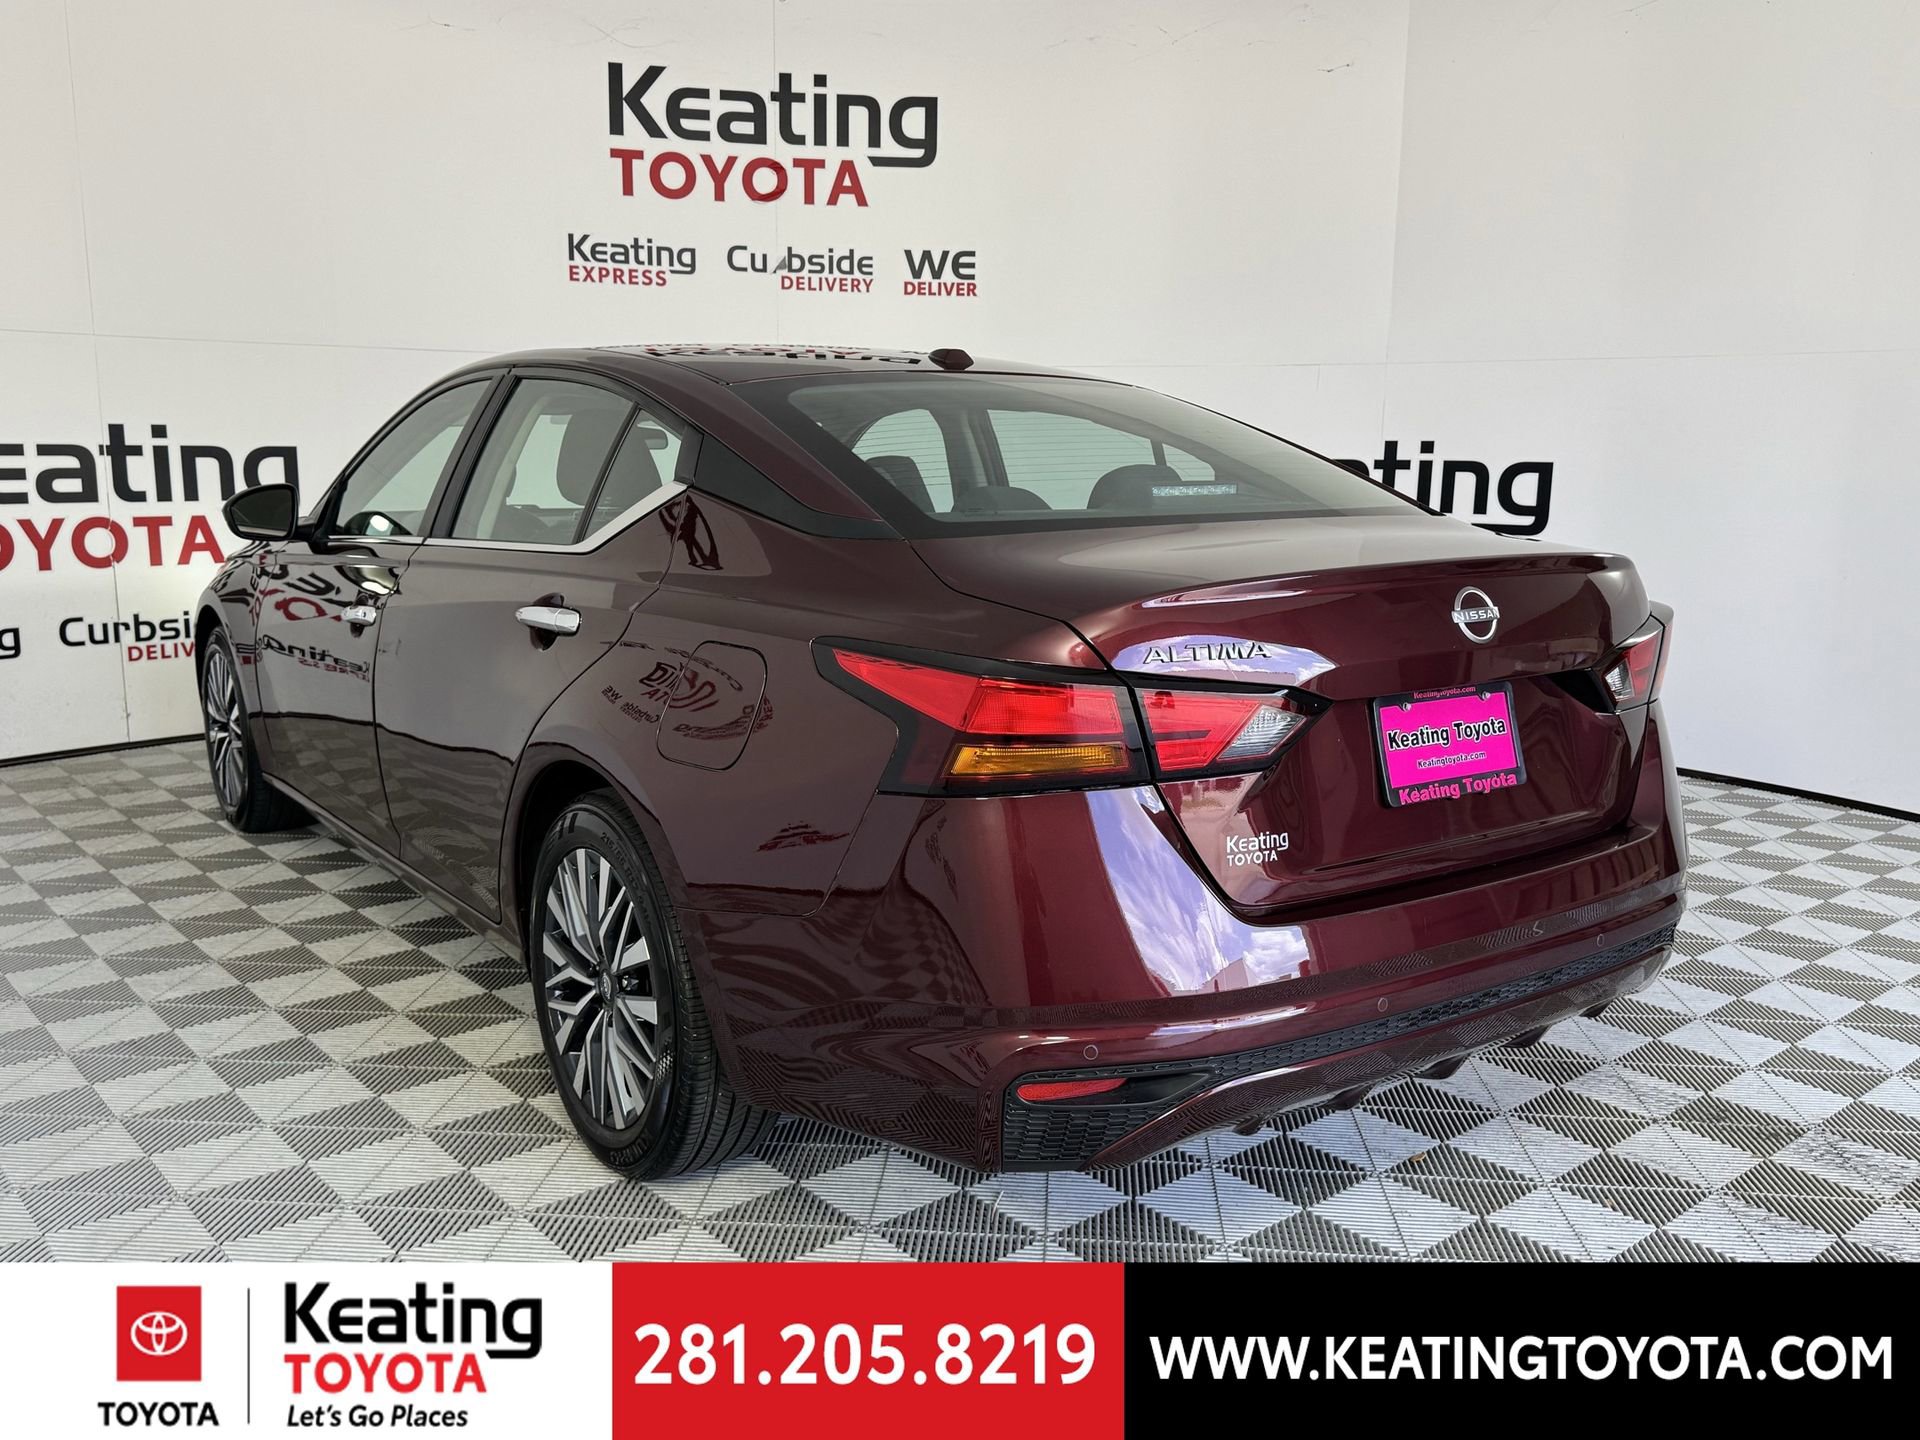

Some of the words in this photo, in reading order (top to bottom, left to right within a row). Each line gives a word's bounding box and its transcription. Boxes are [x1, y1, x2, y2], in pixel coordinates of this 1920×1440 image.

[608, 62, 938, 168] Keating
[609, 148, 869, 207] TOYOTA
[568, 233, 696, 275] Keating
[727, 245, 873, 276] Cubside
[904, 250, 976, 280] WE
[569, 265, 667, 286] EXPRESS
[781, 275, 873, 293] DELIVERY
[904, 281, 977, 297] DELIVER
[1454, 608, 1500, 622] NISSAN
[1144, 642, 1272, 664] ALTIMA
[1387, 724, 1450, 750] Keating
[1453, 717, 1507, 742] Toyota
[1399, 780, 1460, 805] Keating
[1463, 772, 1517, 794] Toyota
[1226, 831, 1289, 853] Keating
[1227, 851, 1278, 866] TOYOTA
